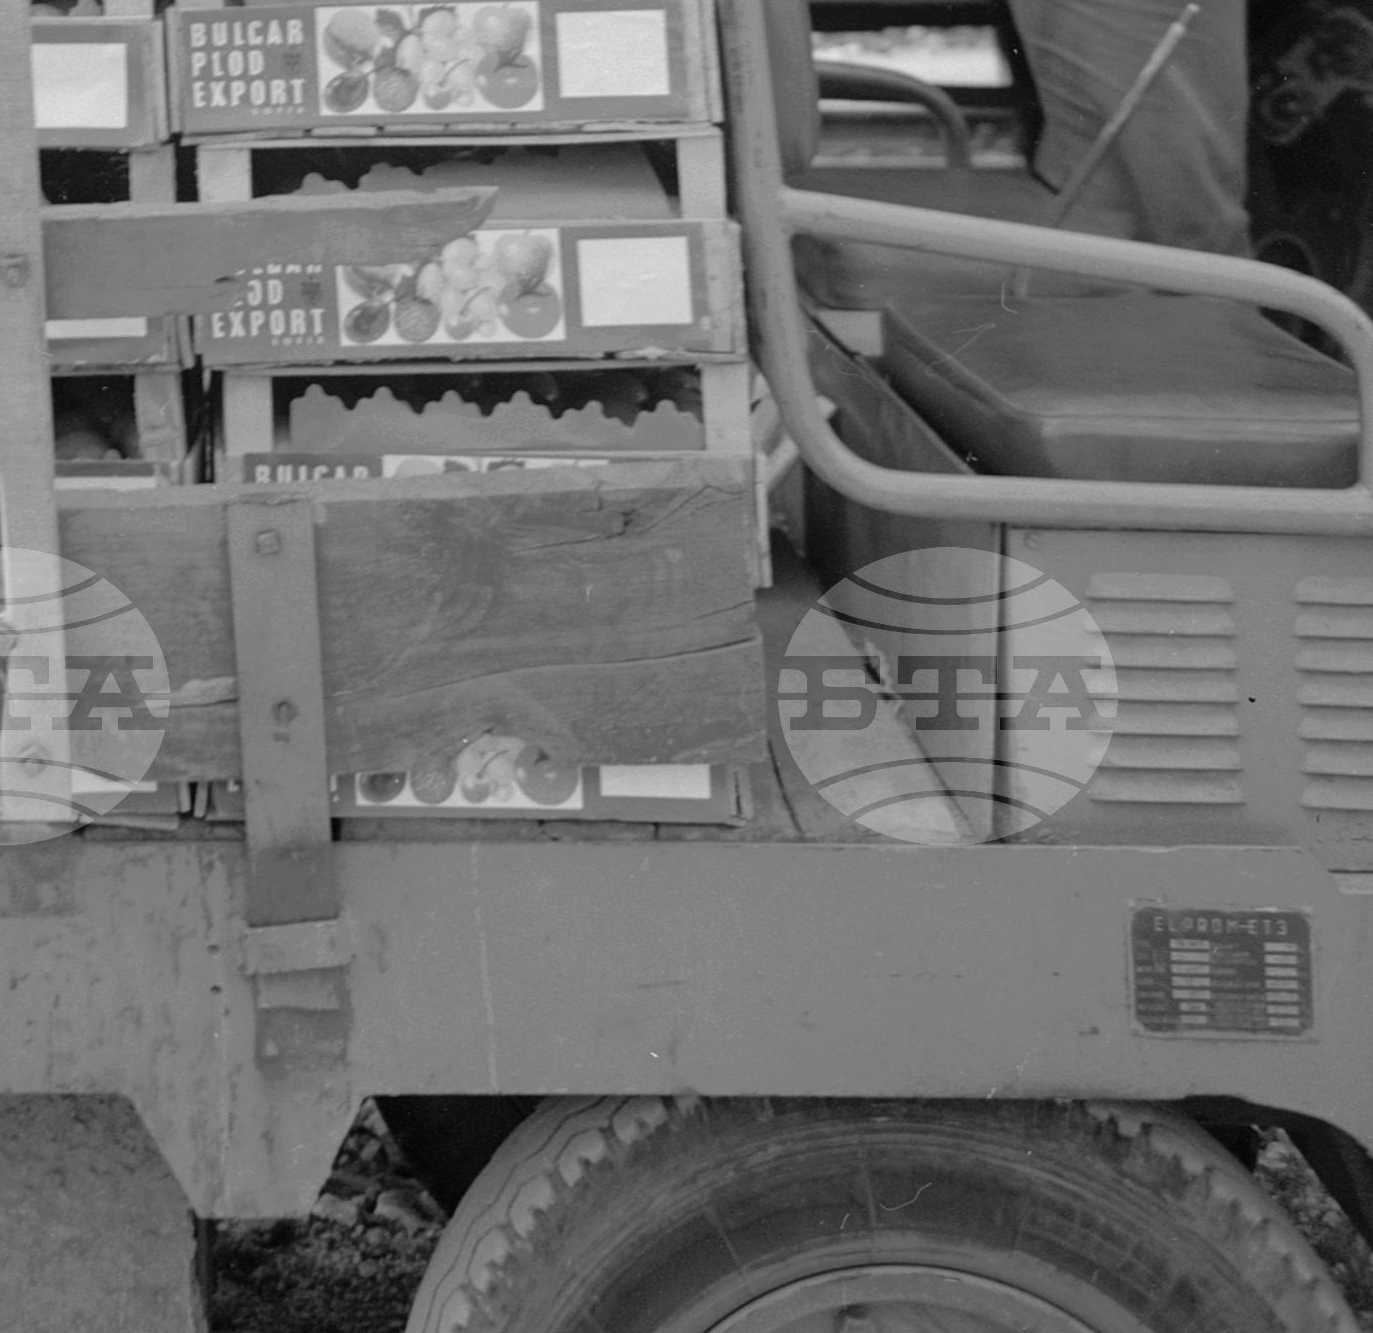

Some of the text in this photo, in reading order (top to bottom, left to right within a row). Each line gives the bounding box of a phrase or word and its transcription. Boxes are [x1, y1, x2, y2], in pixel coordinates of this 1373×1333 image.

[191, 50, 264, 77] PLOD
[192, 78, 306, 108] EXPORT
[211, 308, 326, 339] EXPORT
